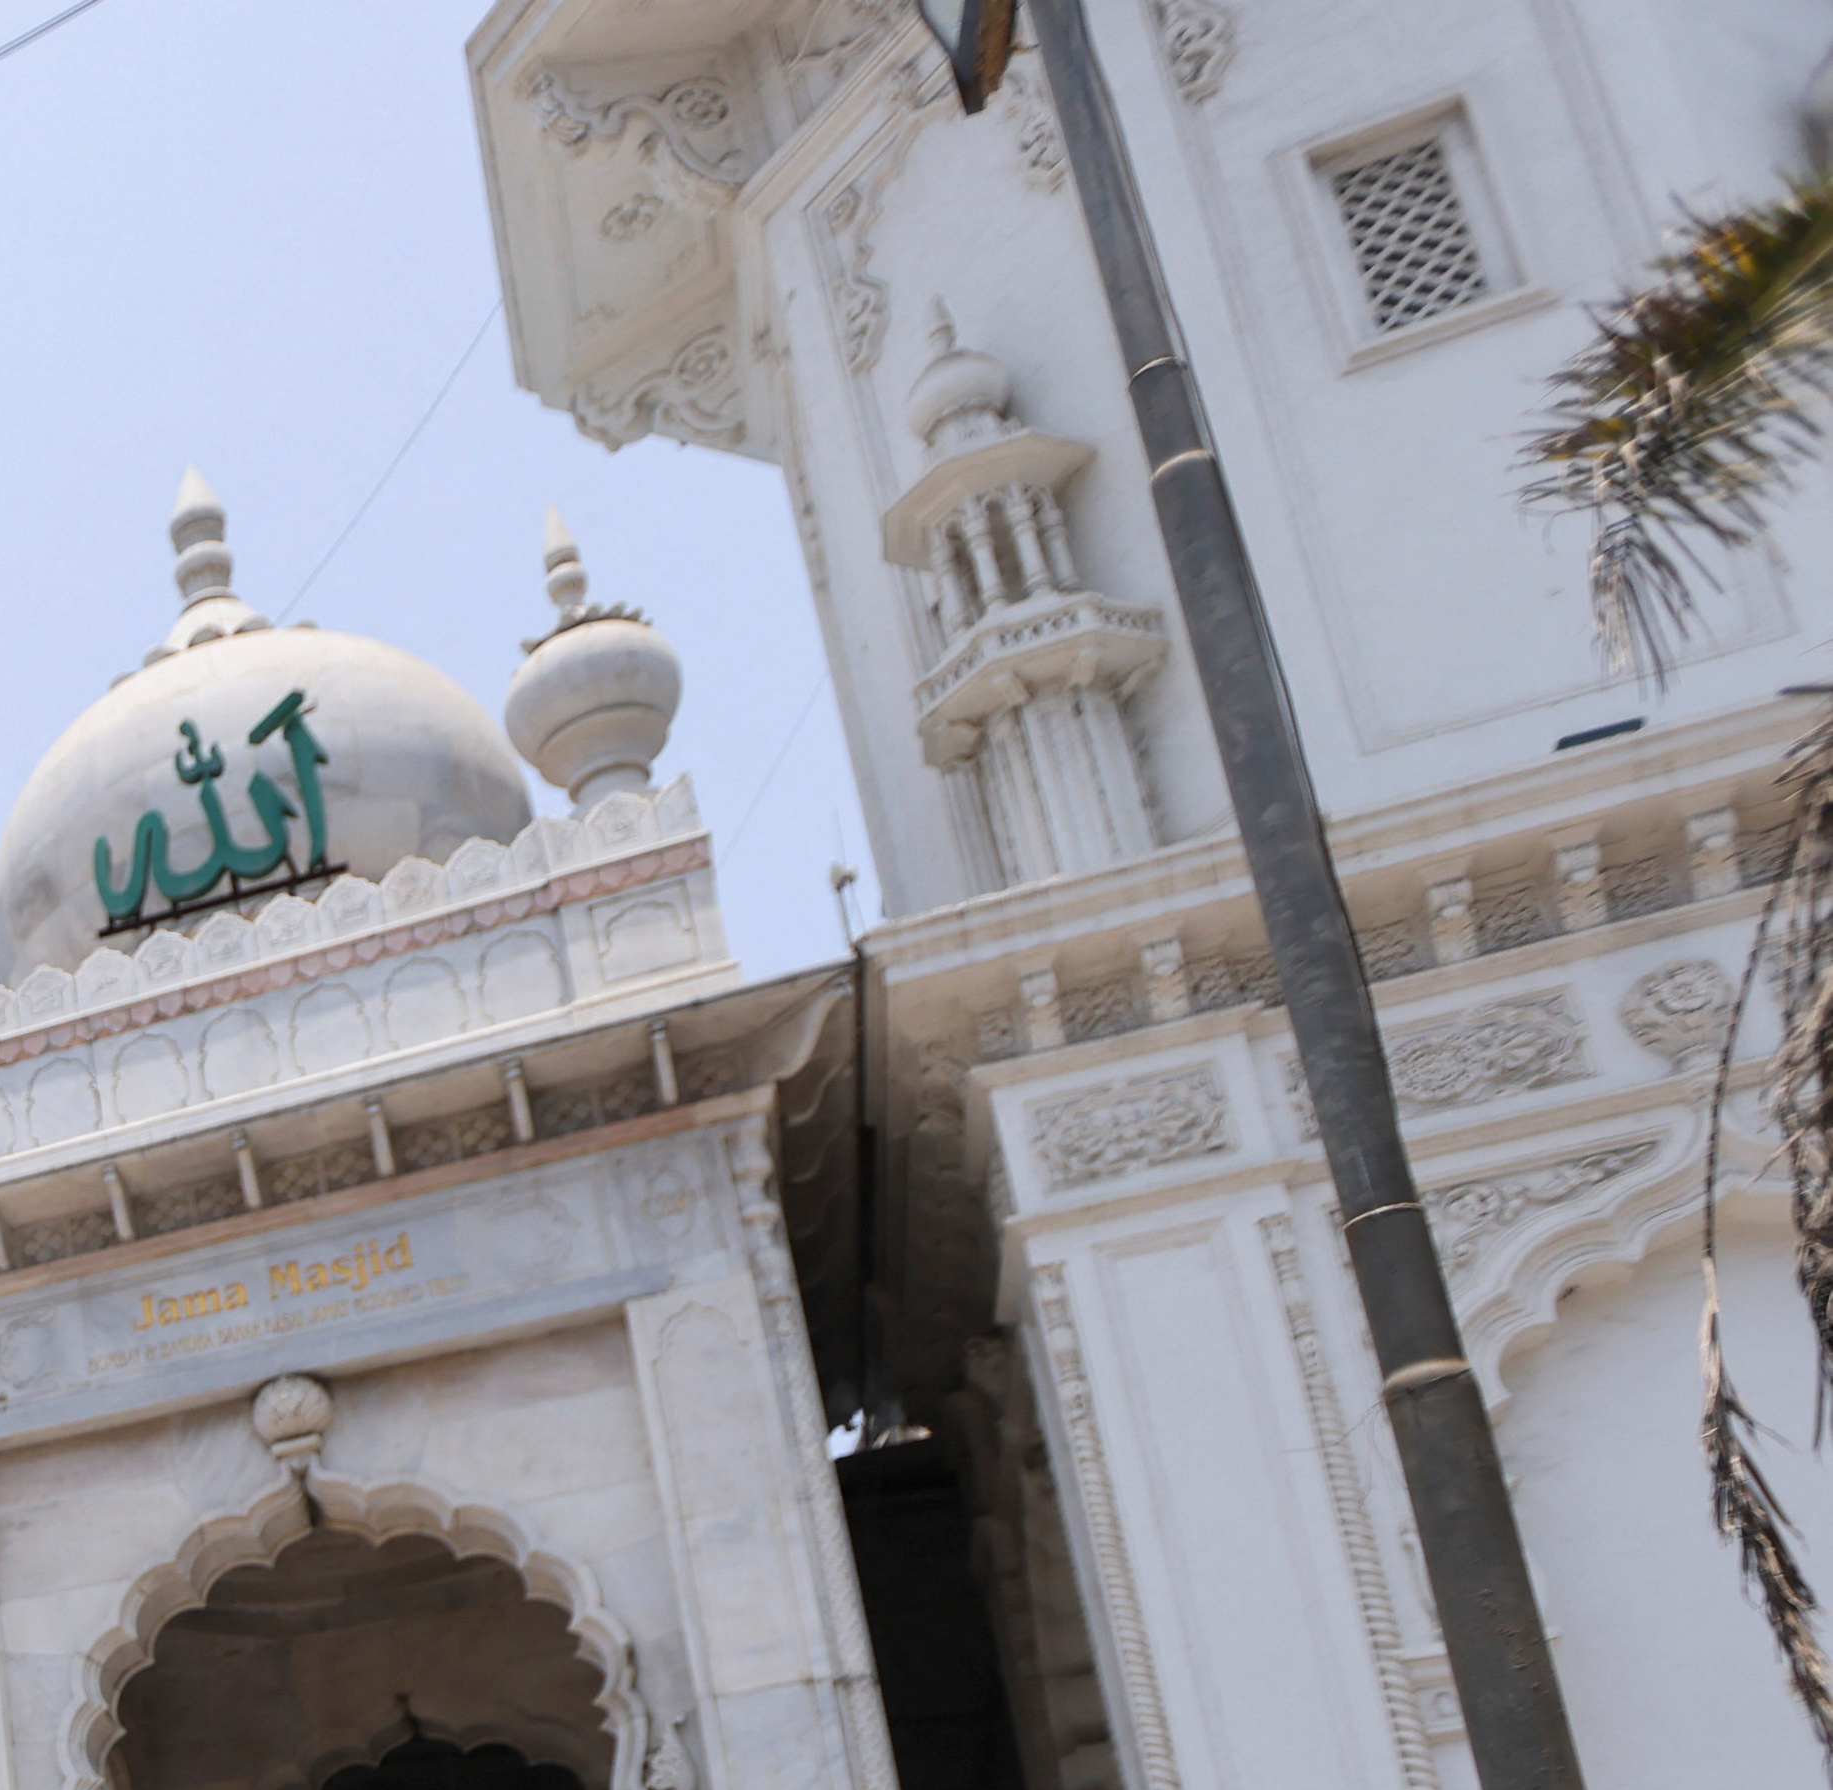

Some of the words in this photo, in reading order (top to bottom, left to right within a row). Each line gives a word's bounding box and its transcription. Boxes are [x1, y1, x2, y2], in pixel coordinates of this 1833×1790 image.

[95, 690, 328, 918] الله
[133, 1281, 250, 1332] Jama
[267, 1232, 414, 1300] Masjid
